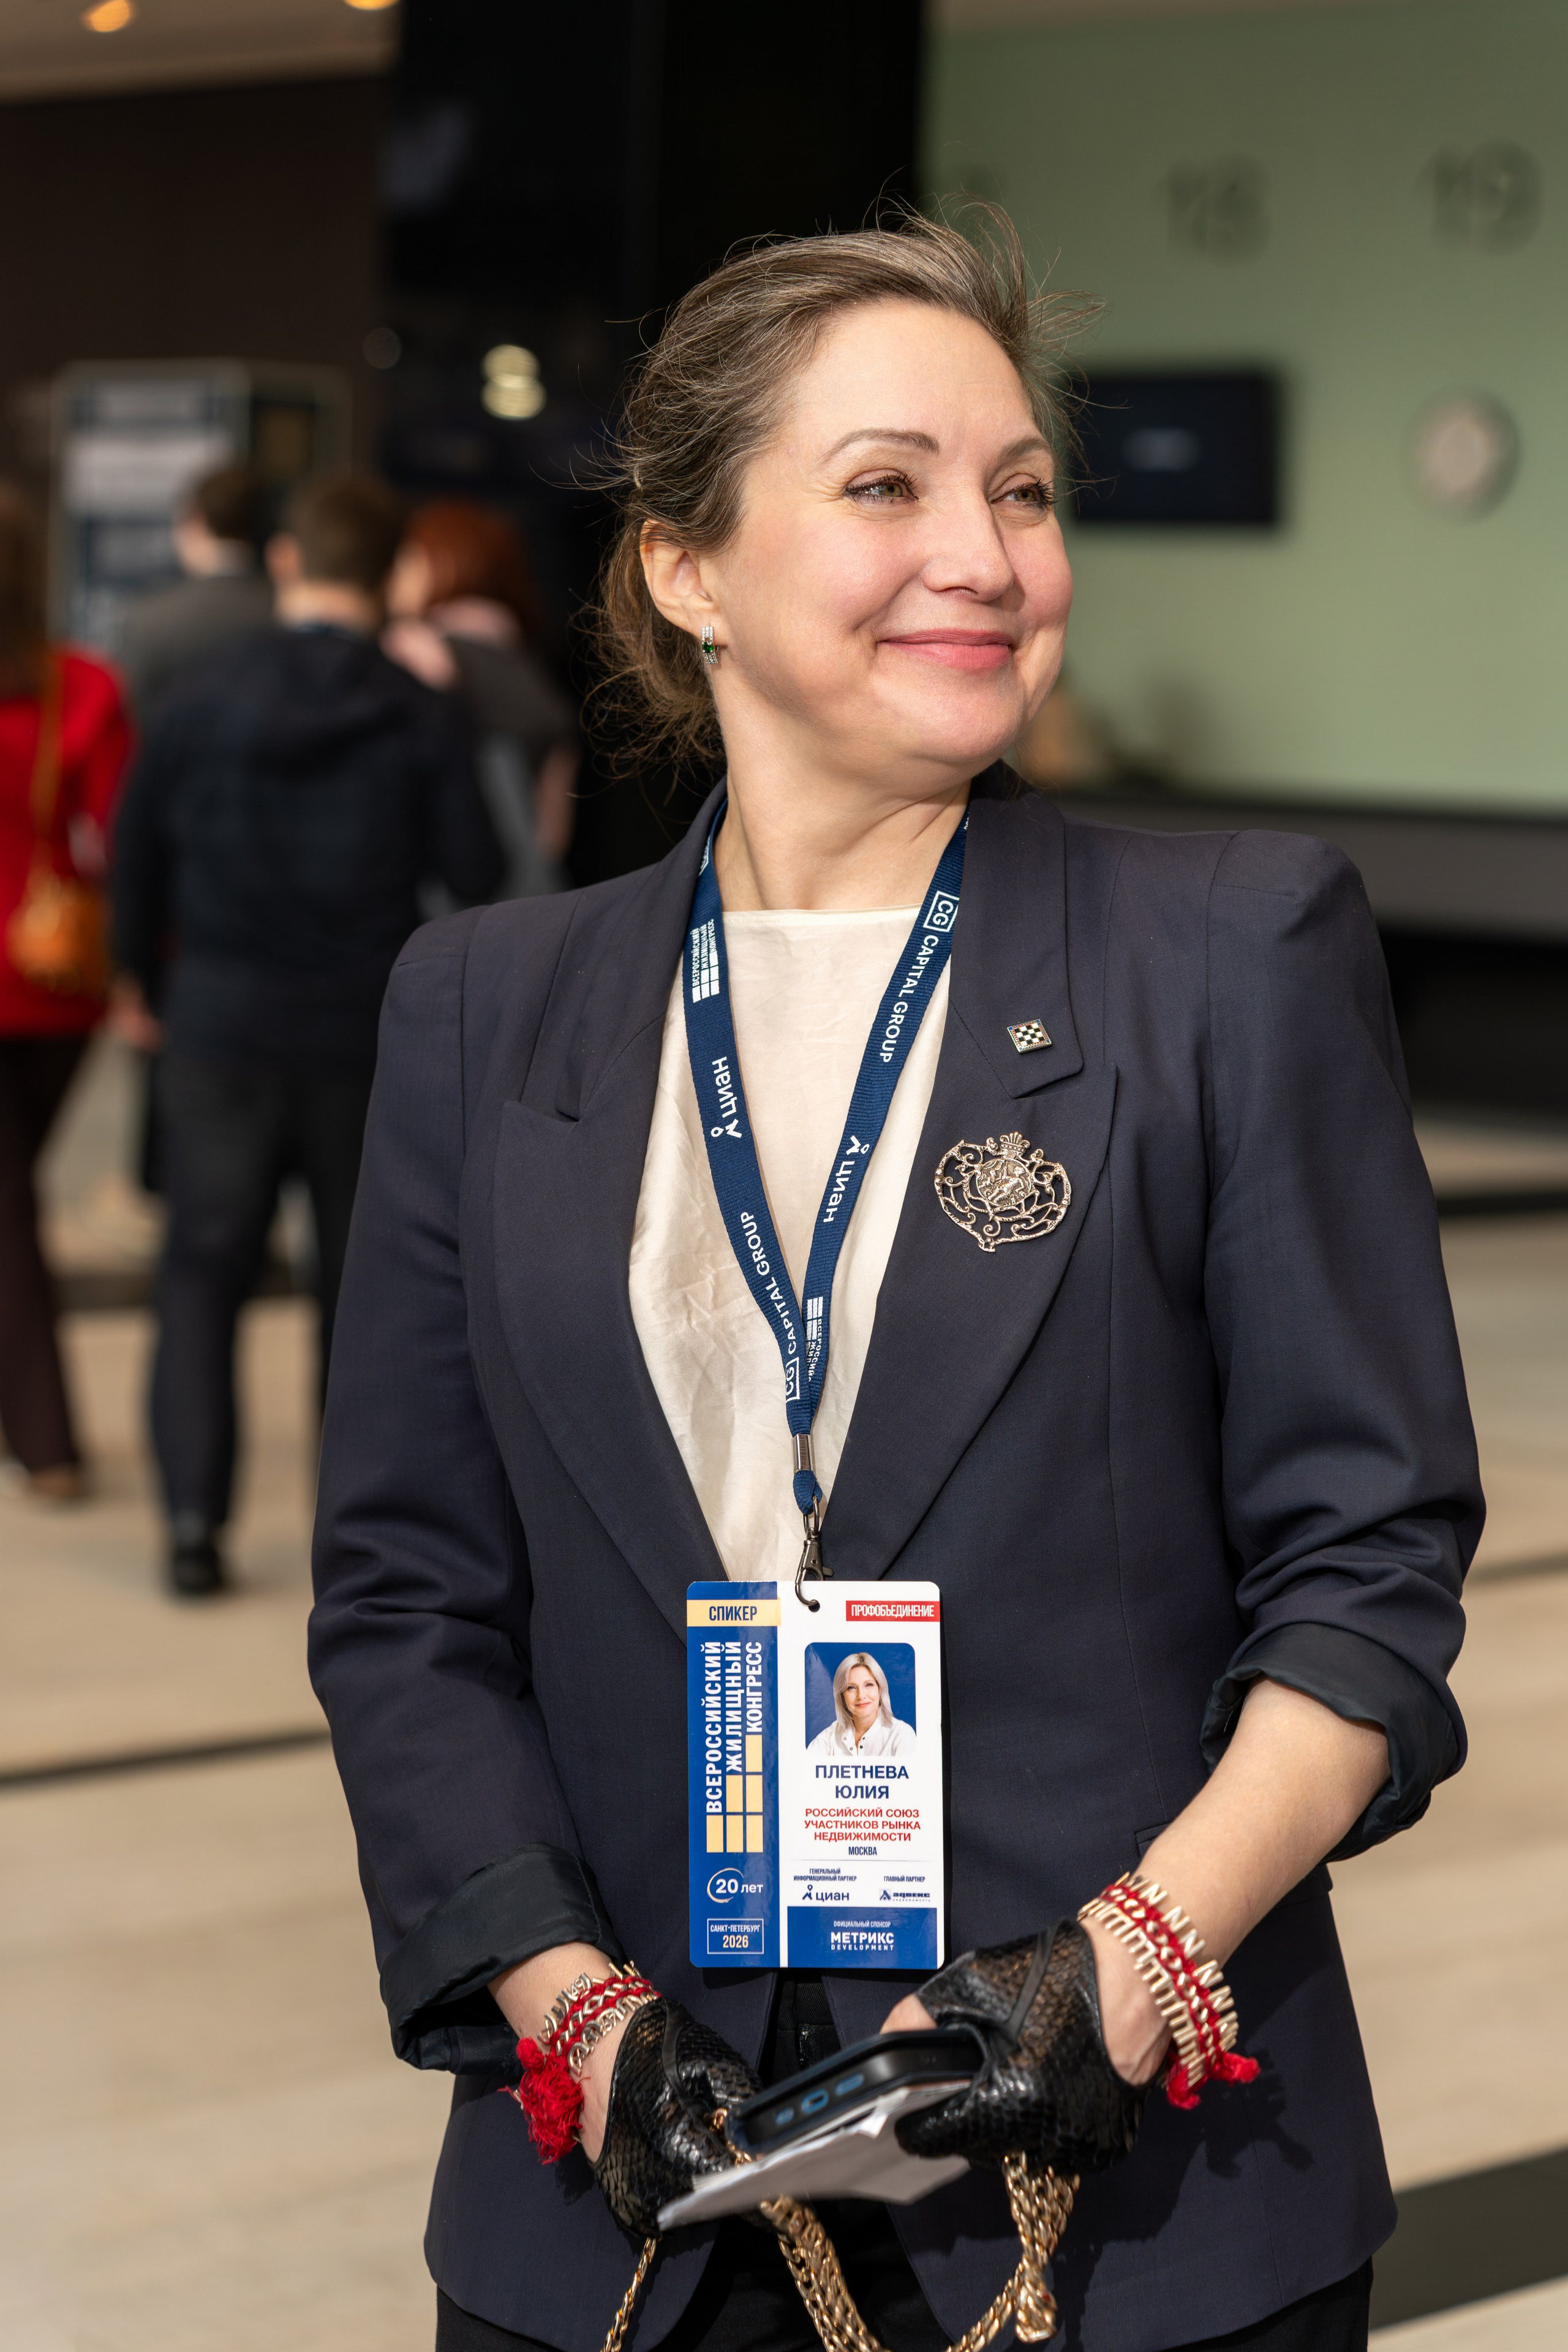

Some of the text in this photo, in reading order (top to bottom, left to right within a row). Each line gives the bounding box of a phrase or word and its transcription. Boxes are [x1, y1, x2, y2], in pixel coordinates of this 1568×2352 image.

[707, 919, 717, 954] КОНГРЕСС
[699, 924, 709, 970] ЖИЛИЩНЫЙ
[690, 927, 700, 987] ВСЕРОССИЙСКИЙ
[880, 900, 954, 1063] CG CAPITAL GROUP
[712, 1056, 737, 1118] циан
[823, 1161, 855, 1223] циан
[741, 1212, 770, 1276] GROUP
[766, 1276, 796, 1355] CAPITAL
[709, 1605, 758, 1621] СПИКЕР
[851, 1604, 935, 1618] ПРОФОБЪЕДИНЕНИЕ
[745, 1642, 763, 1733] КОНГРЕСС
[721, 1642, 744, 1773] ЖИЛИЩНЫЙ
[701, 1642, 722, 1813] ВСЕРОССИЙСКИЙ
[815, 1765, 910, 1779] ПЛЕТНЕВА
[835, 1785, 889, 1799] ЮЛИЯ
[805, 1807, 919, 1818] РОССИЙСКИЙ СОЮЗ
[804, 1820, 921, 1830] УЧАСТНИКОВ РЫНКА
[814, 1832, 911, 1842] НЕДВИЖИМОСТИ
[848, 1846, 877, 1855] МОСКВА
[715, 1879, 764, 1894] 20 лет
[815, 1892, 850, 1902] циан
[710, 1924, 761, 1933] САНКТ-ПЕТЕРБУРГ
[722, 1934, 748, 1948] 2026
[831, 1931, 894, 1944] МЕТРИКС
